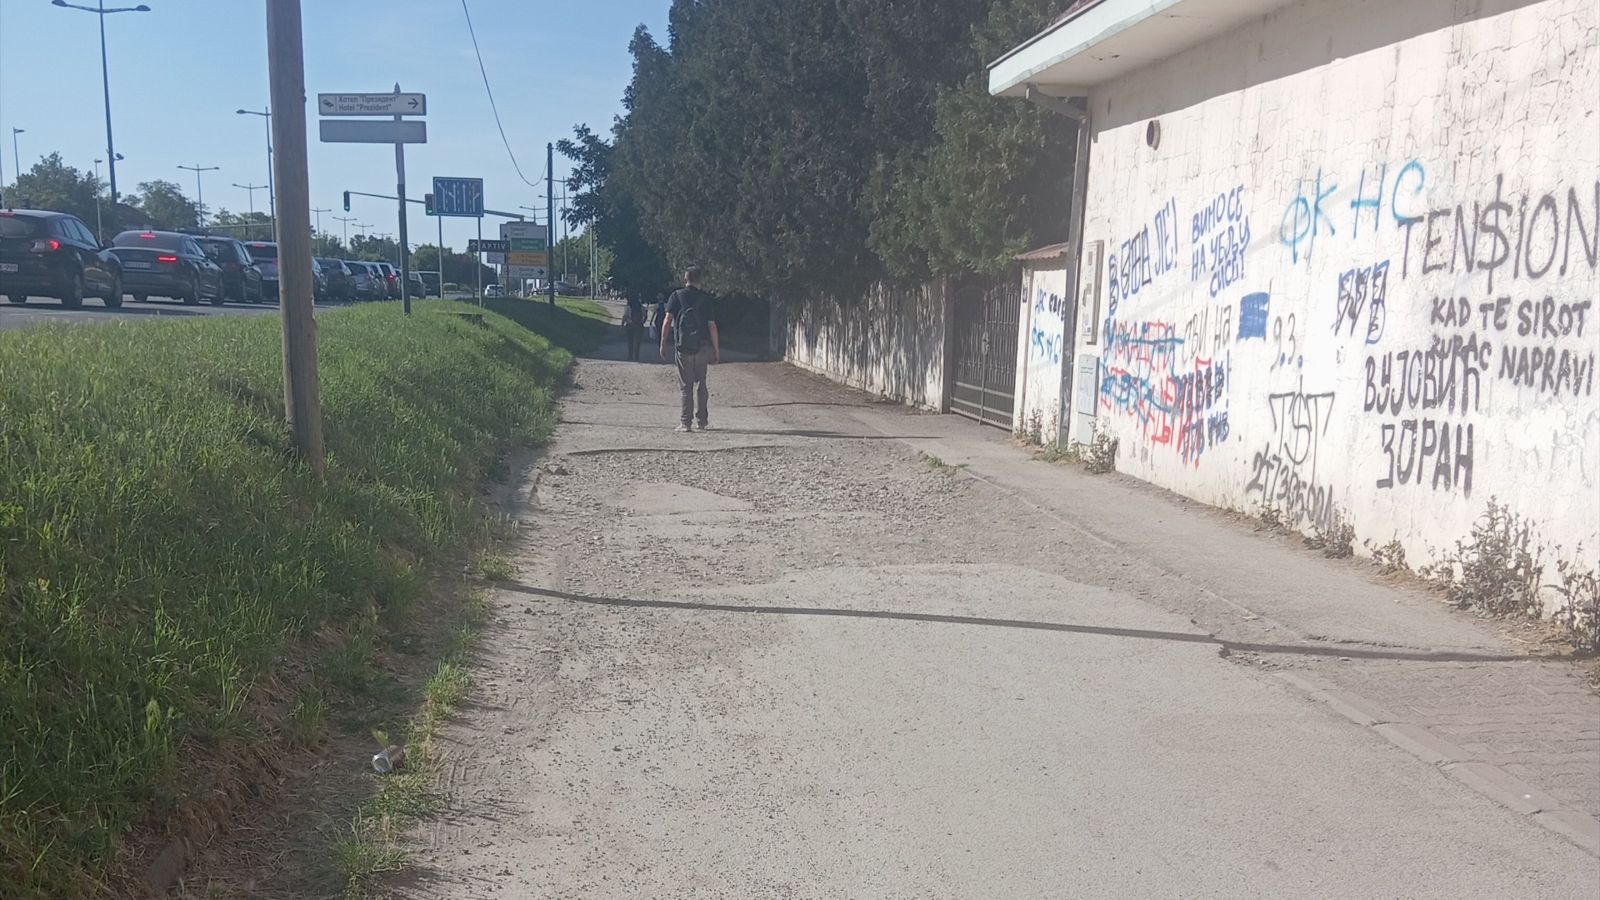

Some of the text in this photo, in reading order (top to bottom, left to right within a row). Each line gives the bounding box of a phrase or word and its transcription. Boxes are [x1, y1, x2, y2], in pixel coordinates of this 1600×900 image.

[1430, 296, 1472, 328] KAD
[1479, 296, 1511, 331] TE
[1517, 294, 1592, 339] SIROT
[1498, 345, 1595, 397] NAPRAVI
[1376, 417, 1474, 499] ЗОРАН
